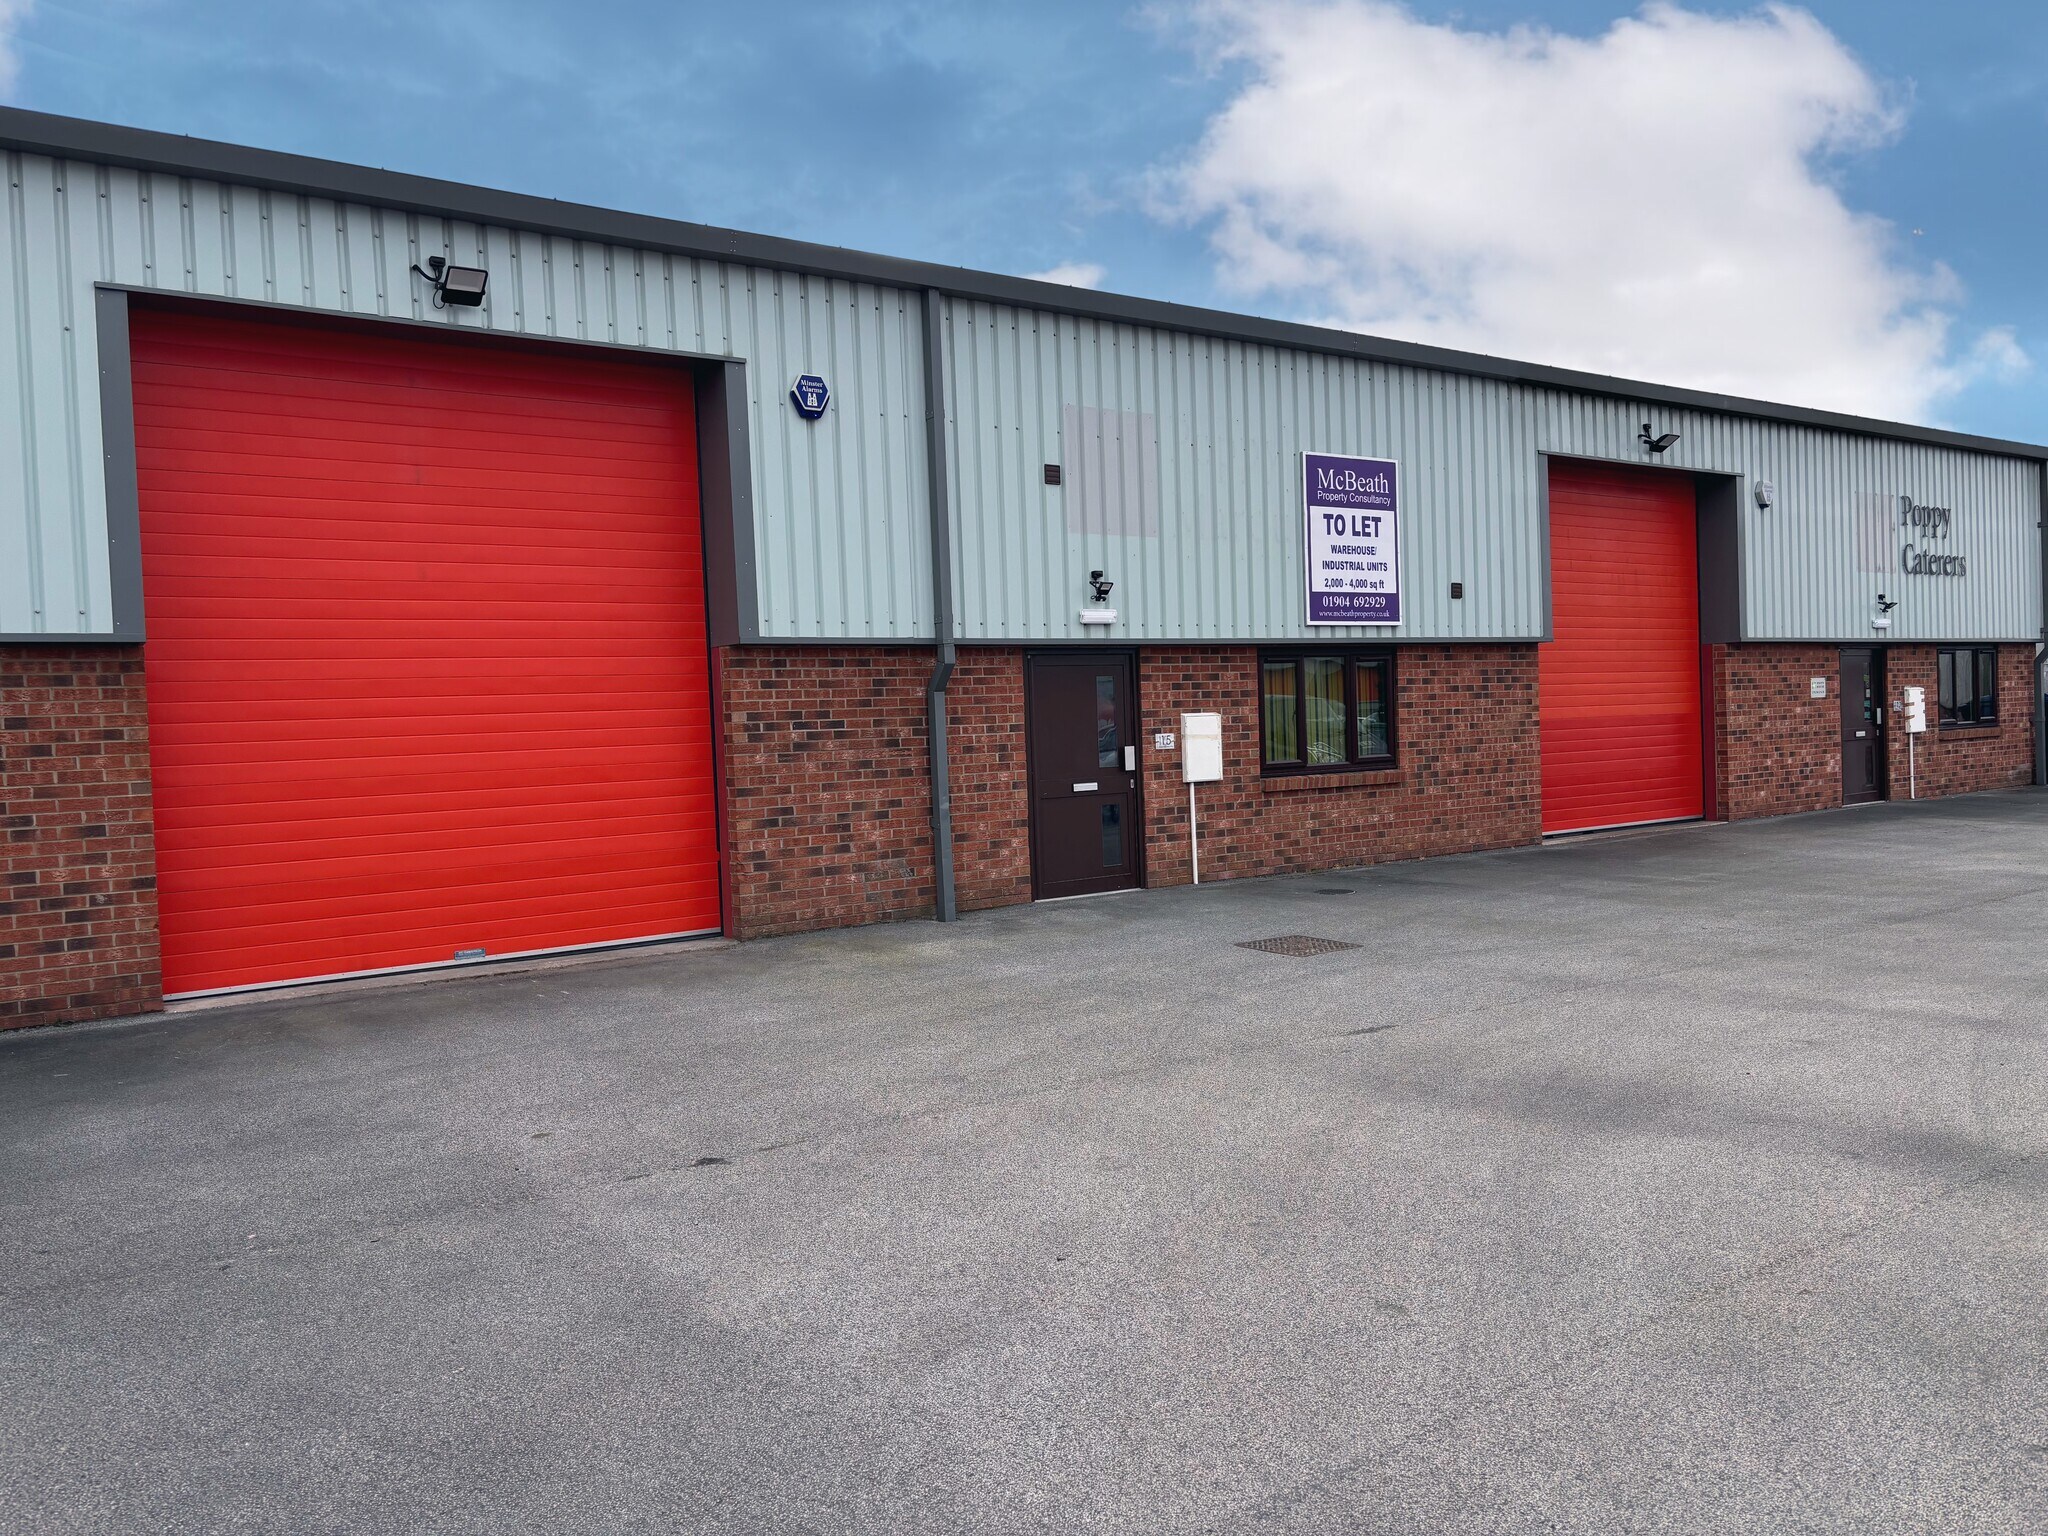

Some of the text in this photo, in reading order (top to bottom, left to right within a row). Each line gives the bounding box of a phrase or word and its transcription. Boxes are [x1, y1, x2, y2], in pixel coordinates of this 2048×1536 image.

[1317, 468, 1389, 493] McBeath
[1317, 491, 1391, 506] Property Consultancy
[1900, 495, 1951, 540] Poppy
[1323, 513, 1382, 538] TO LET
[1331, 545, 1377, 556] WAREHOUSE/
[1322, 560, 1388, 572] INDUSTRIAL UNITS
[1902, 543, 1967, 577] Caterers
[1324, 578, 1344, 590] 2,000
[1349, 579, 1368, 590] 4,000
[1369, 581, 1378, 591] sq
[1379, 579, 1385, 589] ft
[1322, 595, 1386, 608] 01904 692929
[1318, 609, 1390, 618] www.mcbeathproperty.co.uk
